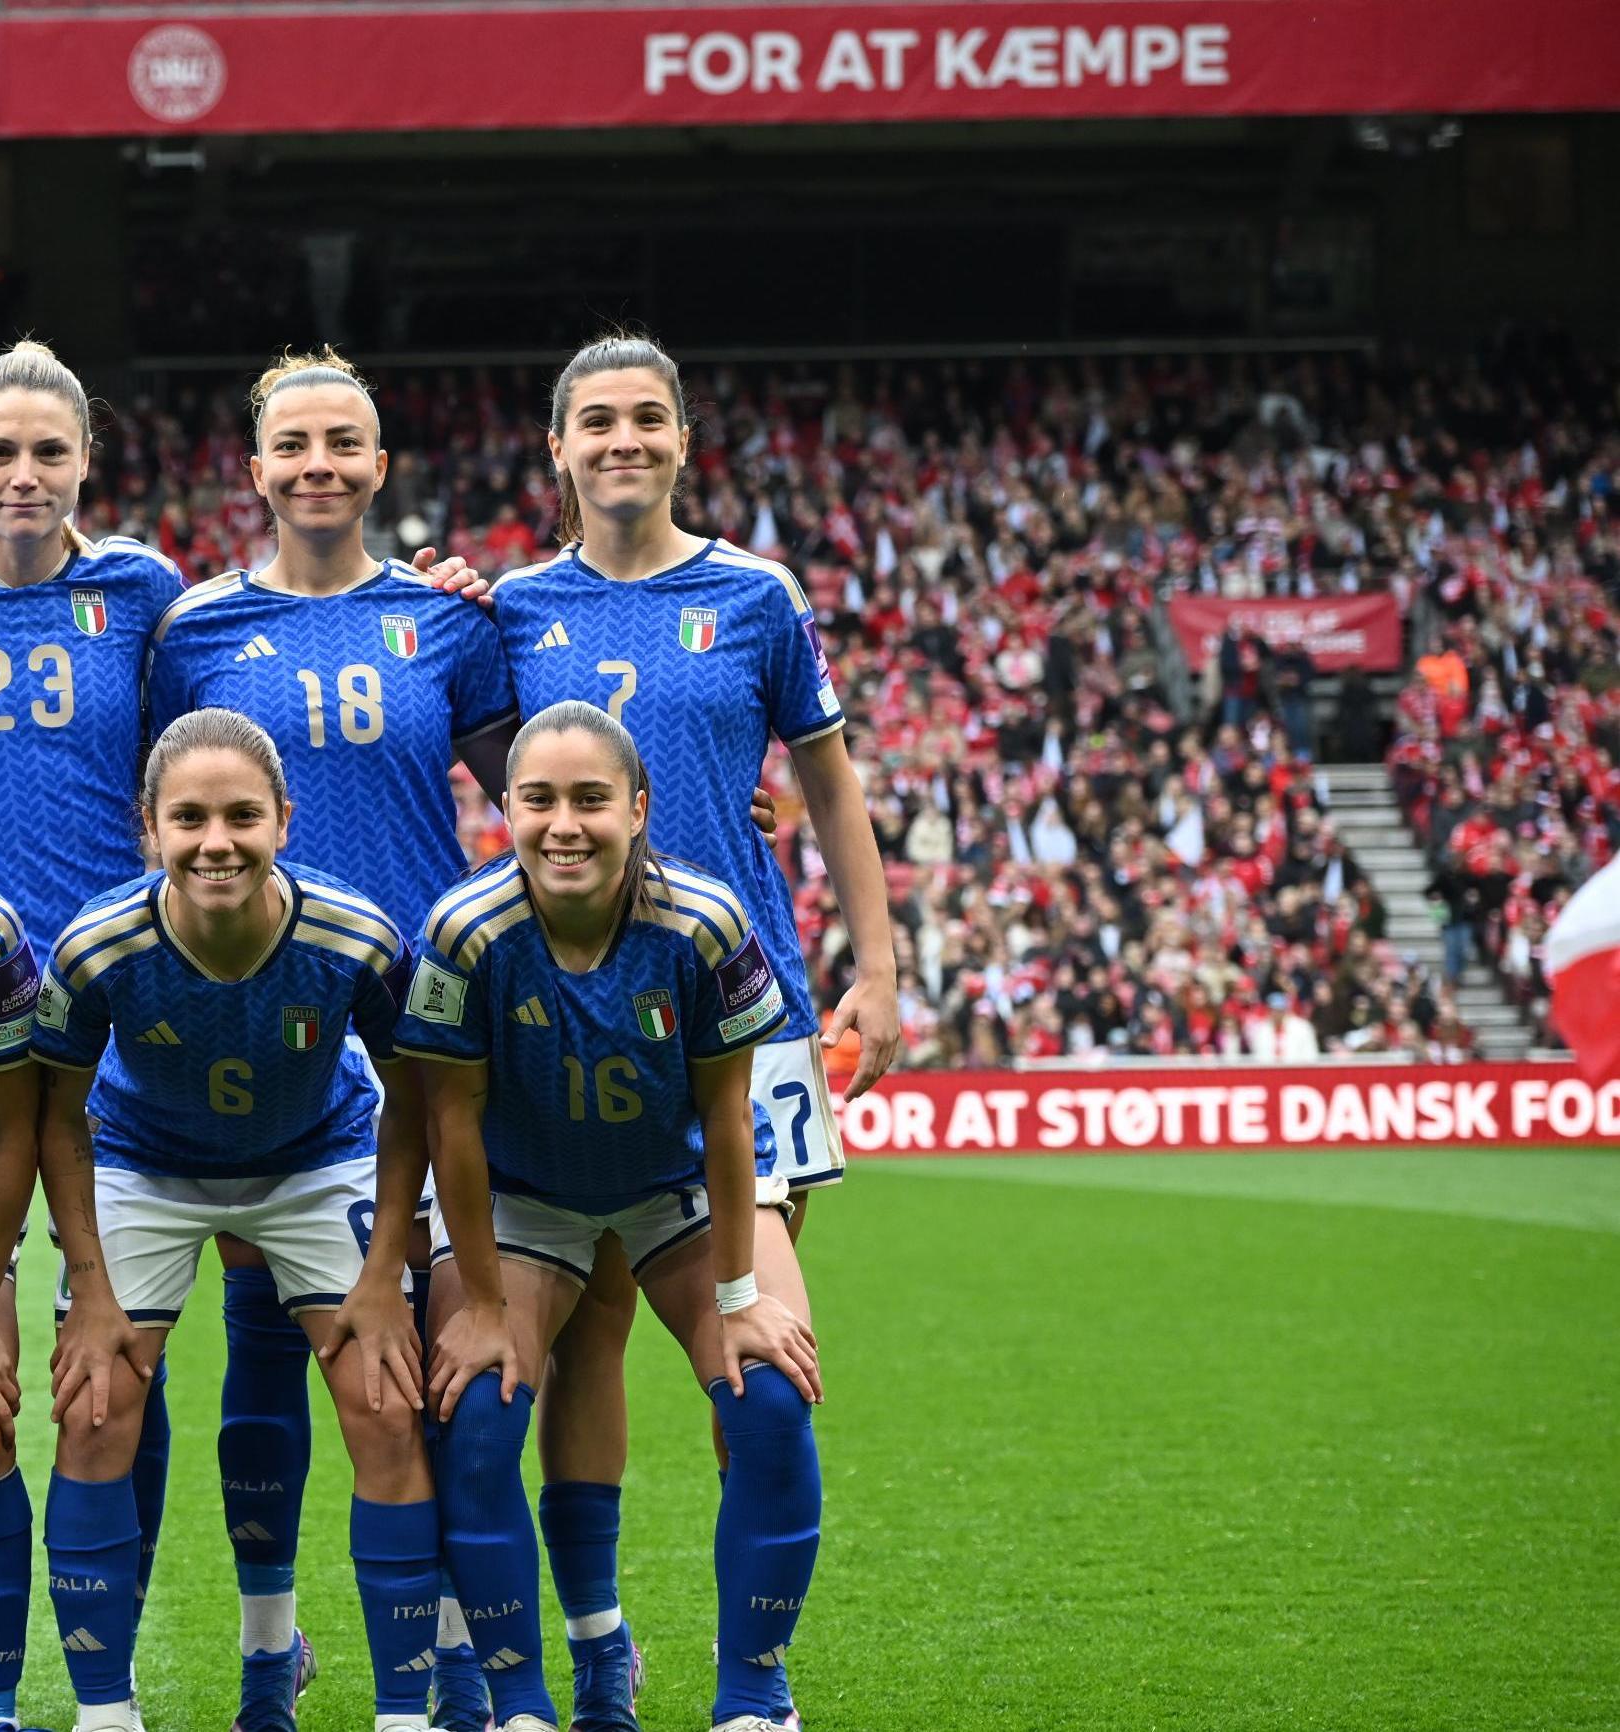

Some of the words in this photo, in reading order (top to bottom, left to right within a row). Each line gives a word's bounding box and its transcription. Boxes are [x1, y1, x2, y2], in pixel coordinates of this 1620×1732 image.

[643, 33, 802, 95] FOR
[816, 29, 918, 91] AT
[934, 24, 1231, 89] KÆMPE
[73, 592, 100, 603] ITALIA
[683, 610, 713, 622] ITALIA
[383, 617, 412, 628] ITALIA
[296, 663, 384, 748] 18
[596, 660, 637, 722] 7
[2, 975, 37, 1007] EUROPEAN
[636, 994, 667, 1008] ITALIA
[728, 965, 766, 1001] EUROPEAN
[285, 1008, 316, 1018] ITALIA
[208, 1057, 254, 1116] 6
[562, 1055, 643, 1123] 16
[772, 1080, 811, 1166] 7
[943, 1091, 1031, 1149] AT
[1037, 1085, 1268, 1147] STØTTE
[1280, 1080, 1499, 1142] DANSK
